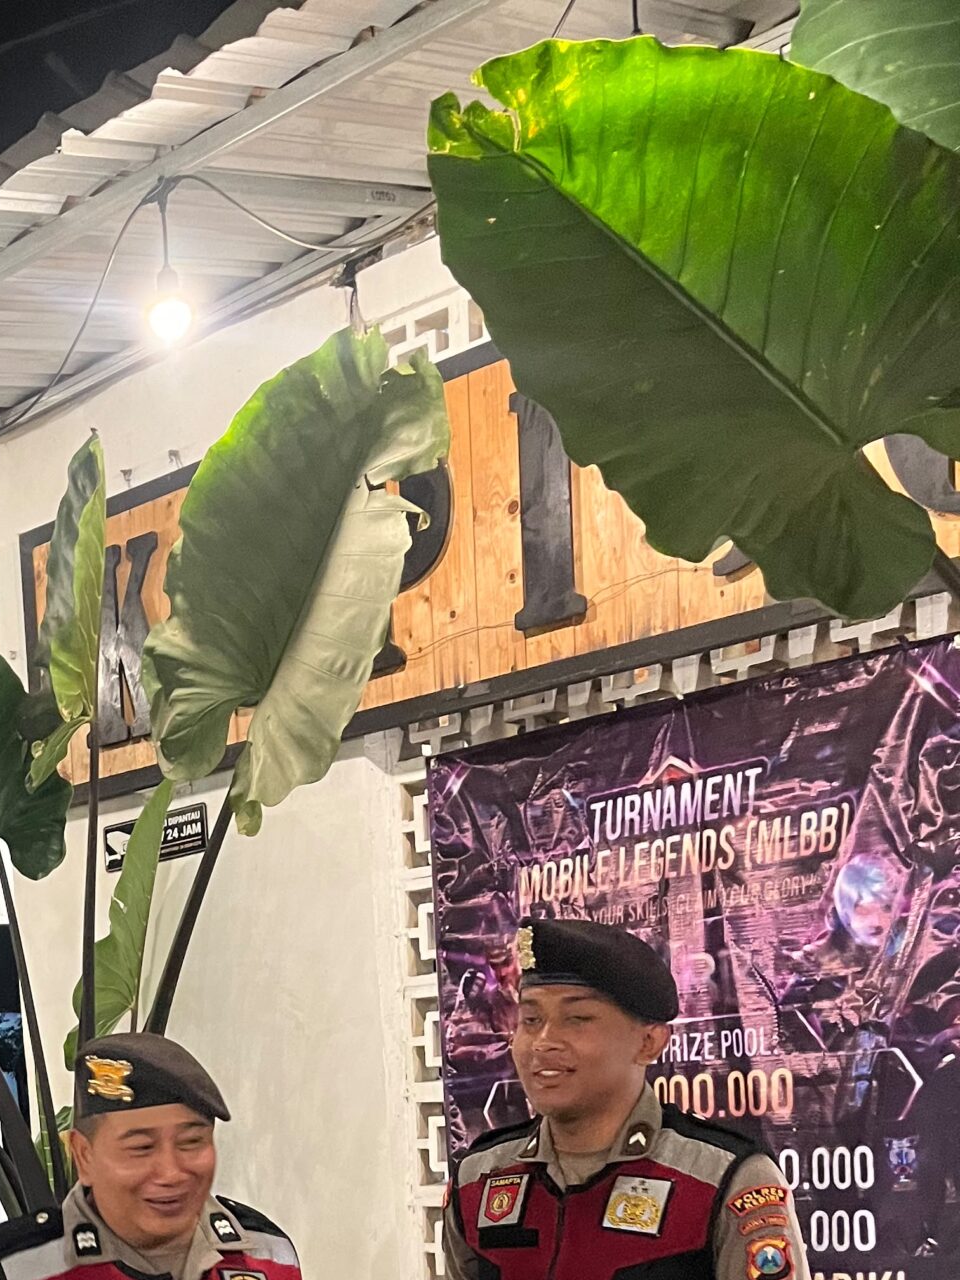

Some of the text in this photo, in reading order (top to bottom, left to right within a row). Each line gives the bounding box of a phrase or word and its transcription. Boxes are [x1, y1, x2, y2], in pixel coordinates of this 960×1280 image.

[590, 766, 763, 843] TURNAMENT
[166, 822, 201, 840] 24 JAM
[519, 802, 851, 903] MOBILE LEGENDS (MLBB)
[654, 1067, 794, 1119] 000.000
[779, 1145, 875, 1191] 0.000
[733, 1187, 785, 1209] POLRES
